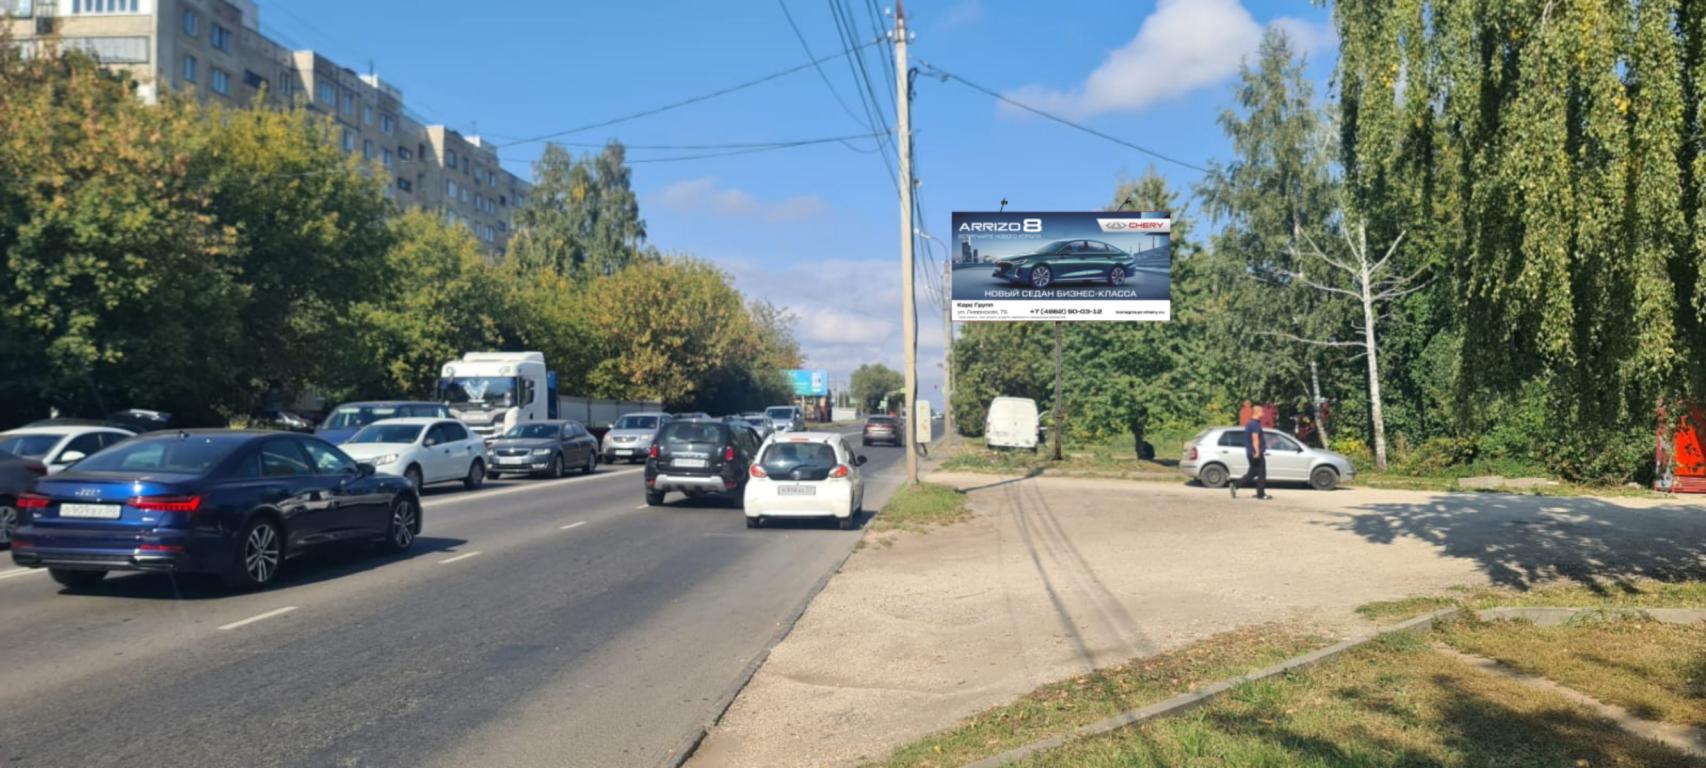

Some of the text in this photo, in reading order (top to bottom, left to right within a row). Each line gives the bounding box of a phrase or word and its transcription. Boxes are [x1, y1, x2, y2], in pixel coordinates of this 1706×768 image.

[959, 218, 1042, 232] ARRIZO 8
[984, 289, 1137, 299] НОВЫЙ СЕДАН БИЗНЕС-КЛАССА
